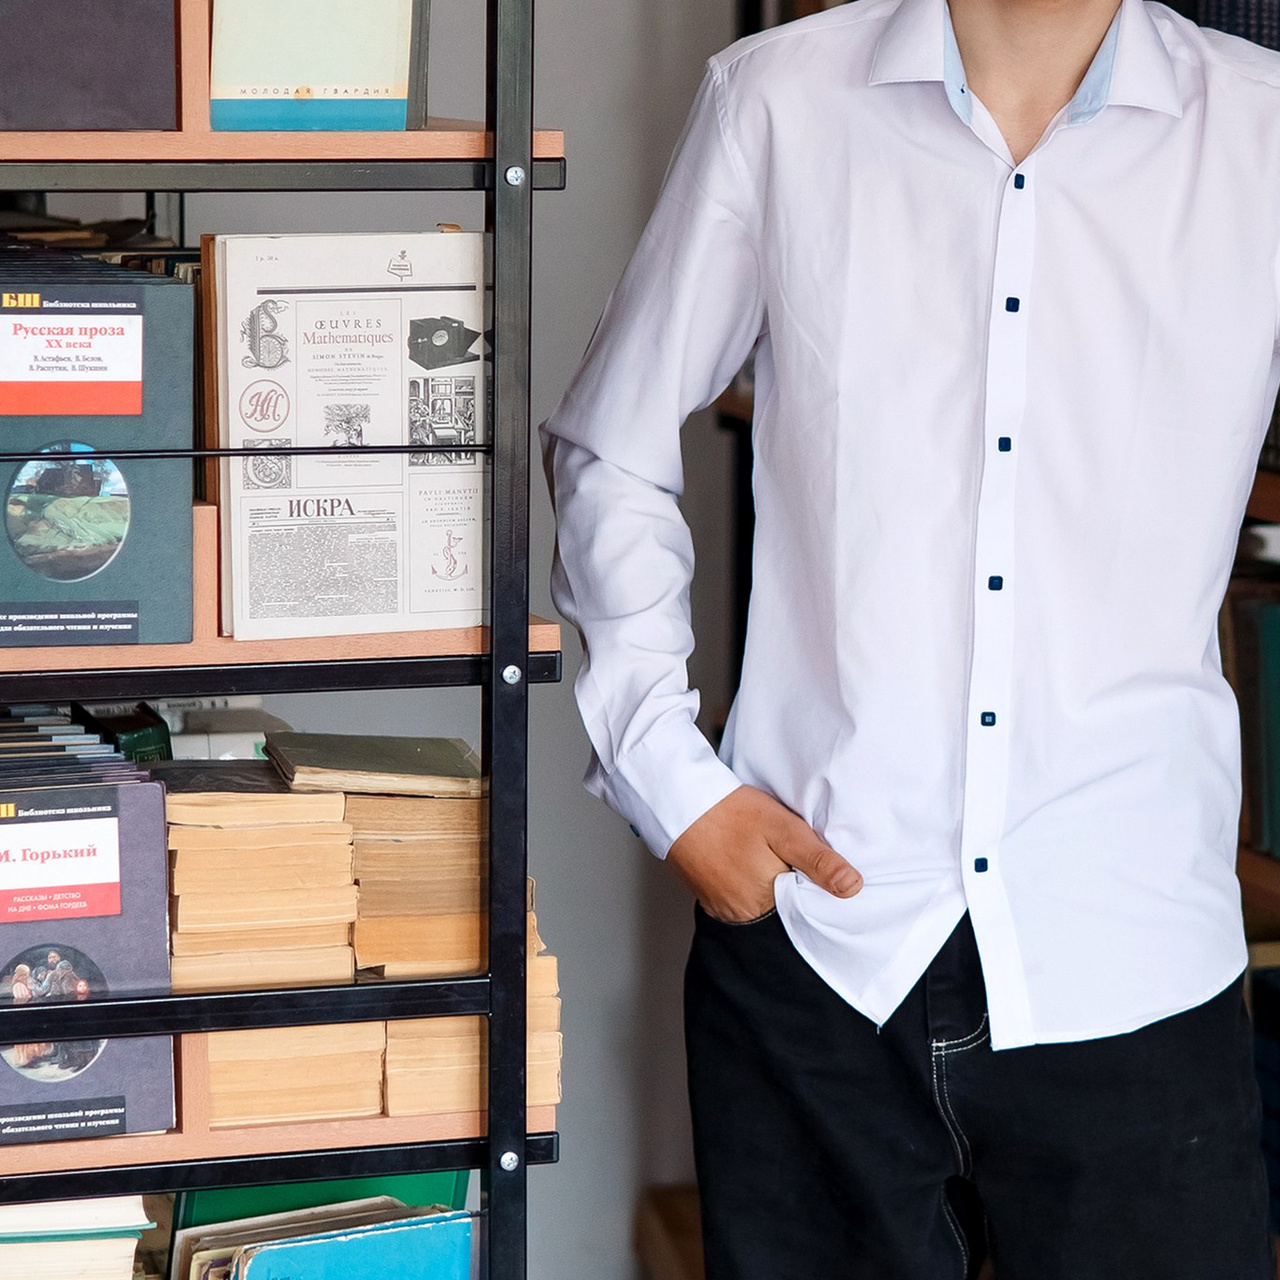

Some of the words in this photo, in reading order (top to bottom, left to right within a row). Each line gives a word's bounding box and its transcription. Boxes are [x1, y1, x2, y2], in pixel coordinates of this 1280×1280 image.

[239, 87, 313, 96] МОЛОДАЯ
[322, 87, 391, 96] ГВАРДИЯ
[1, 292, 41, 309] БШ
[42, 300, 90, 309] Библиотека
[91, 301, 137, 309] школьника
[12, 322, 75, 339] Русская
[78, 326, 125, 339] проза
[65, 340, 92, 349] века
[302, 331, 395, 346] Mathematiques
[288, 498, 356, 519] ИСКРА
[60, 612, 96, 620] школьной
[97, 612, 138, 621] программы
[13, 624, 65, 632] обязательного
[18, 808, 65, 818] Библиотека
[66, 805, 112, 814] школьника
[20, 843, 98, 865] Горький
[13, 894, 48, 904] РАССКАЗЫ
[52, 891, 81, 901] ДЕТСТВО
[8, 906, 17, 914] НА
[37, 902, 59, 911] ФОМА
[60, 900, 87, 910] ГОРДЕЕВ
